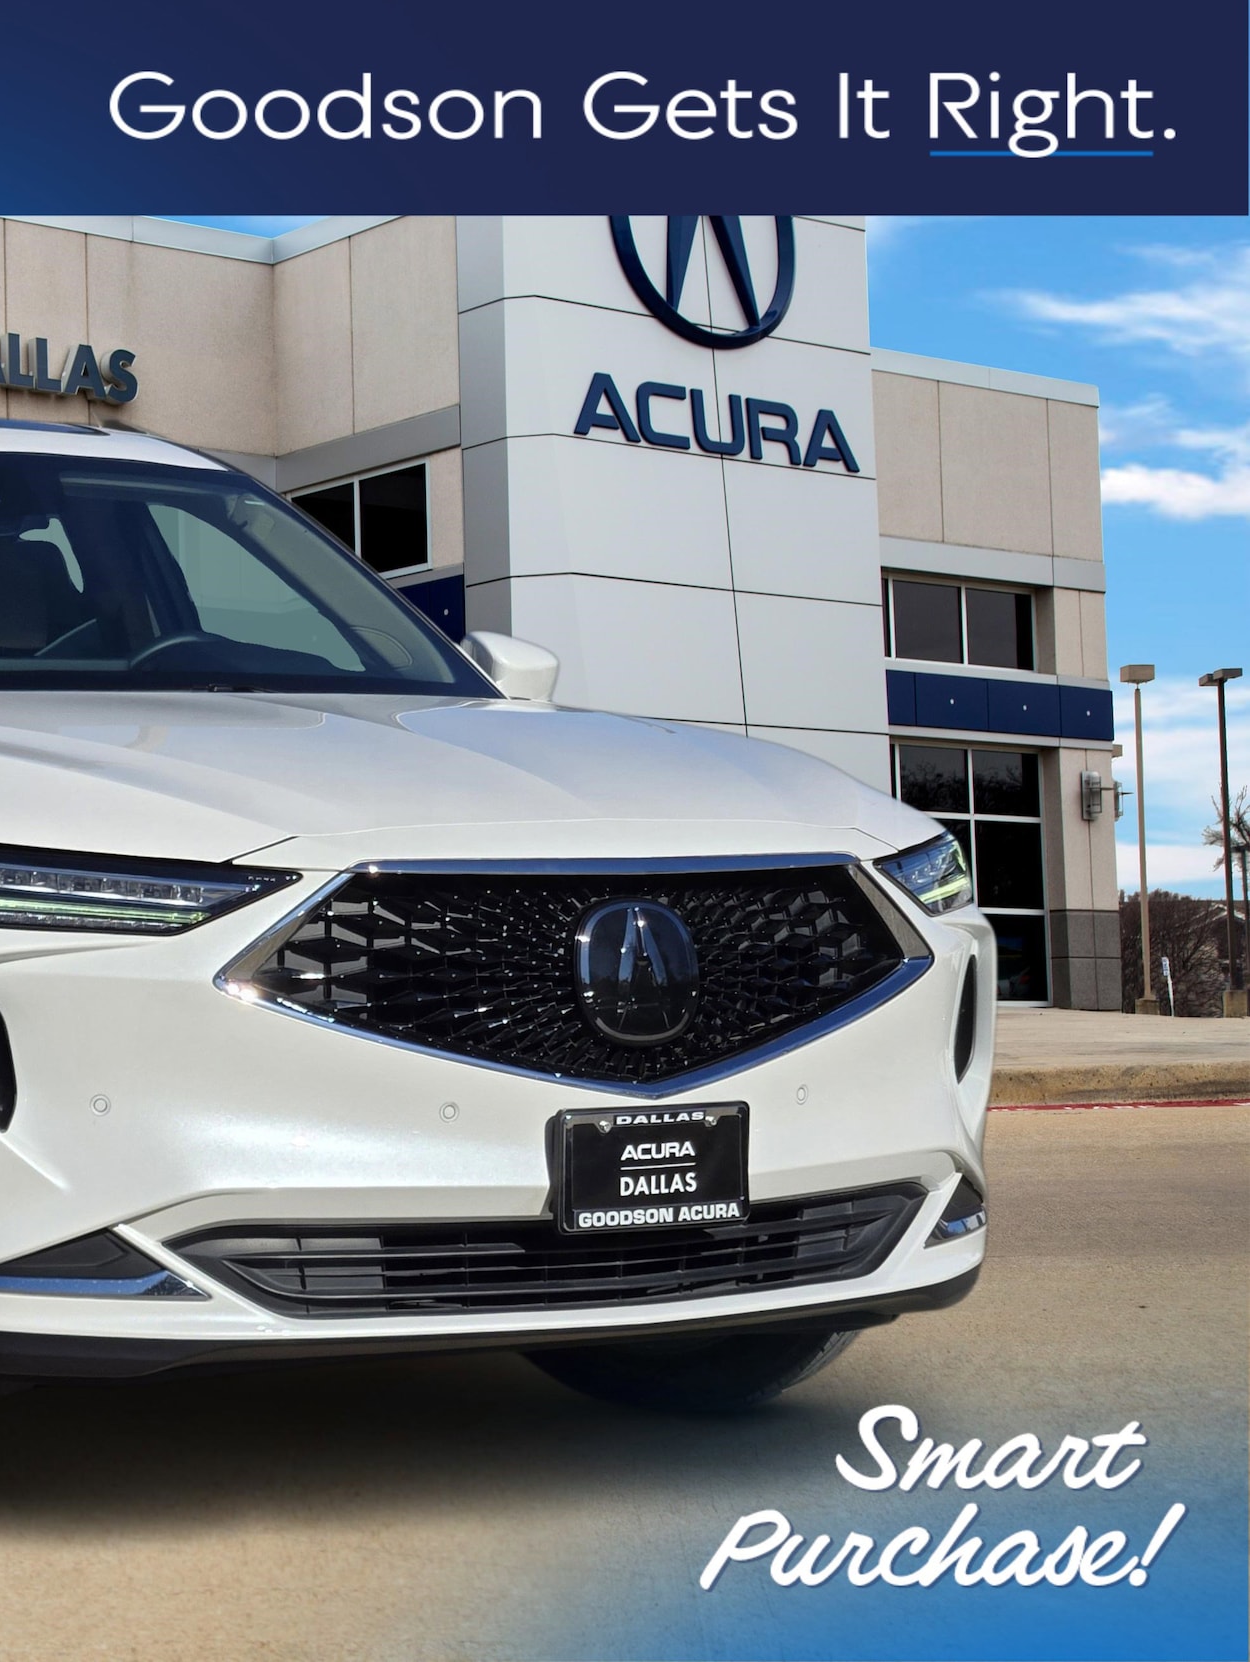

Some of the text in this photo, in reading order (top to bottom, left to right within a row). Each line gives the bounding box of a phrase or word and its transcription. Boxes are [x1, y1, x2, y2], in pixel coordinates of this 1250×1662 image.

[573, 371, 860, 473] ACURA
[616, 1111, 705, 1125] DALLAS
[620, 1141, 696, 1161] ACURA
[620, 1172, 697, 1197] DALLAS
[578, 1202, 740, 1228] GOODSON ACURA
